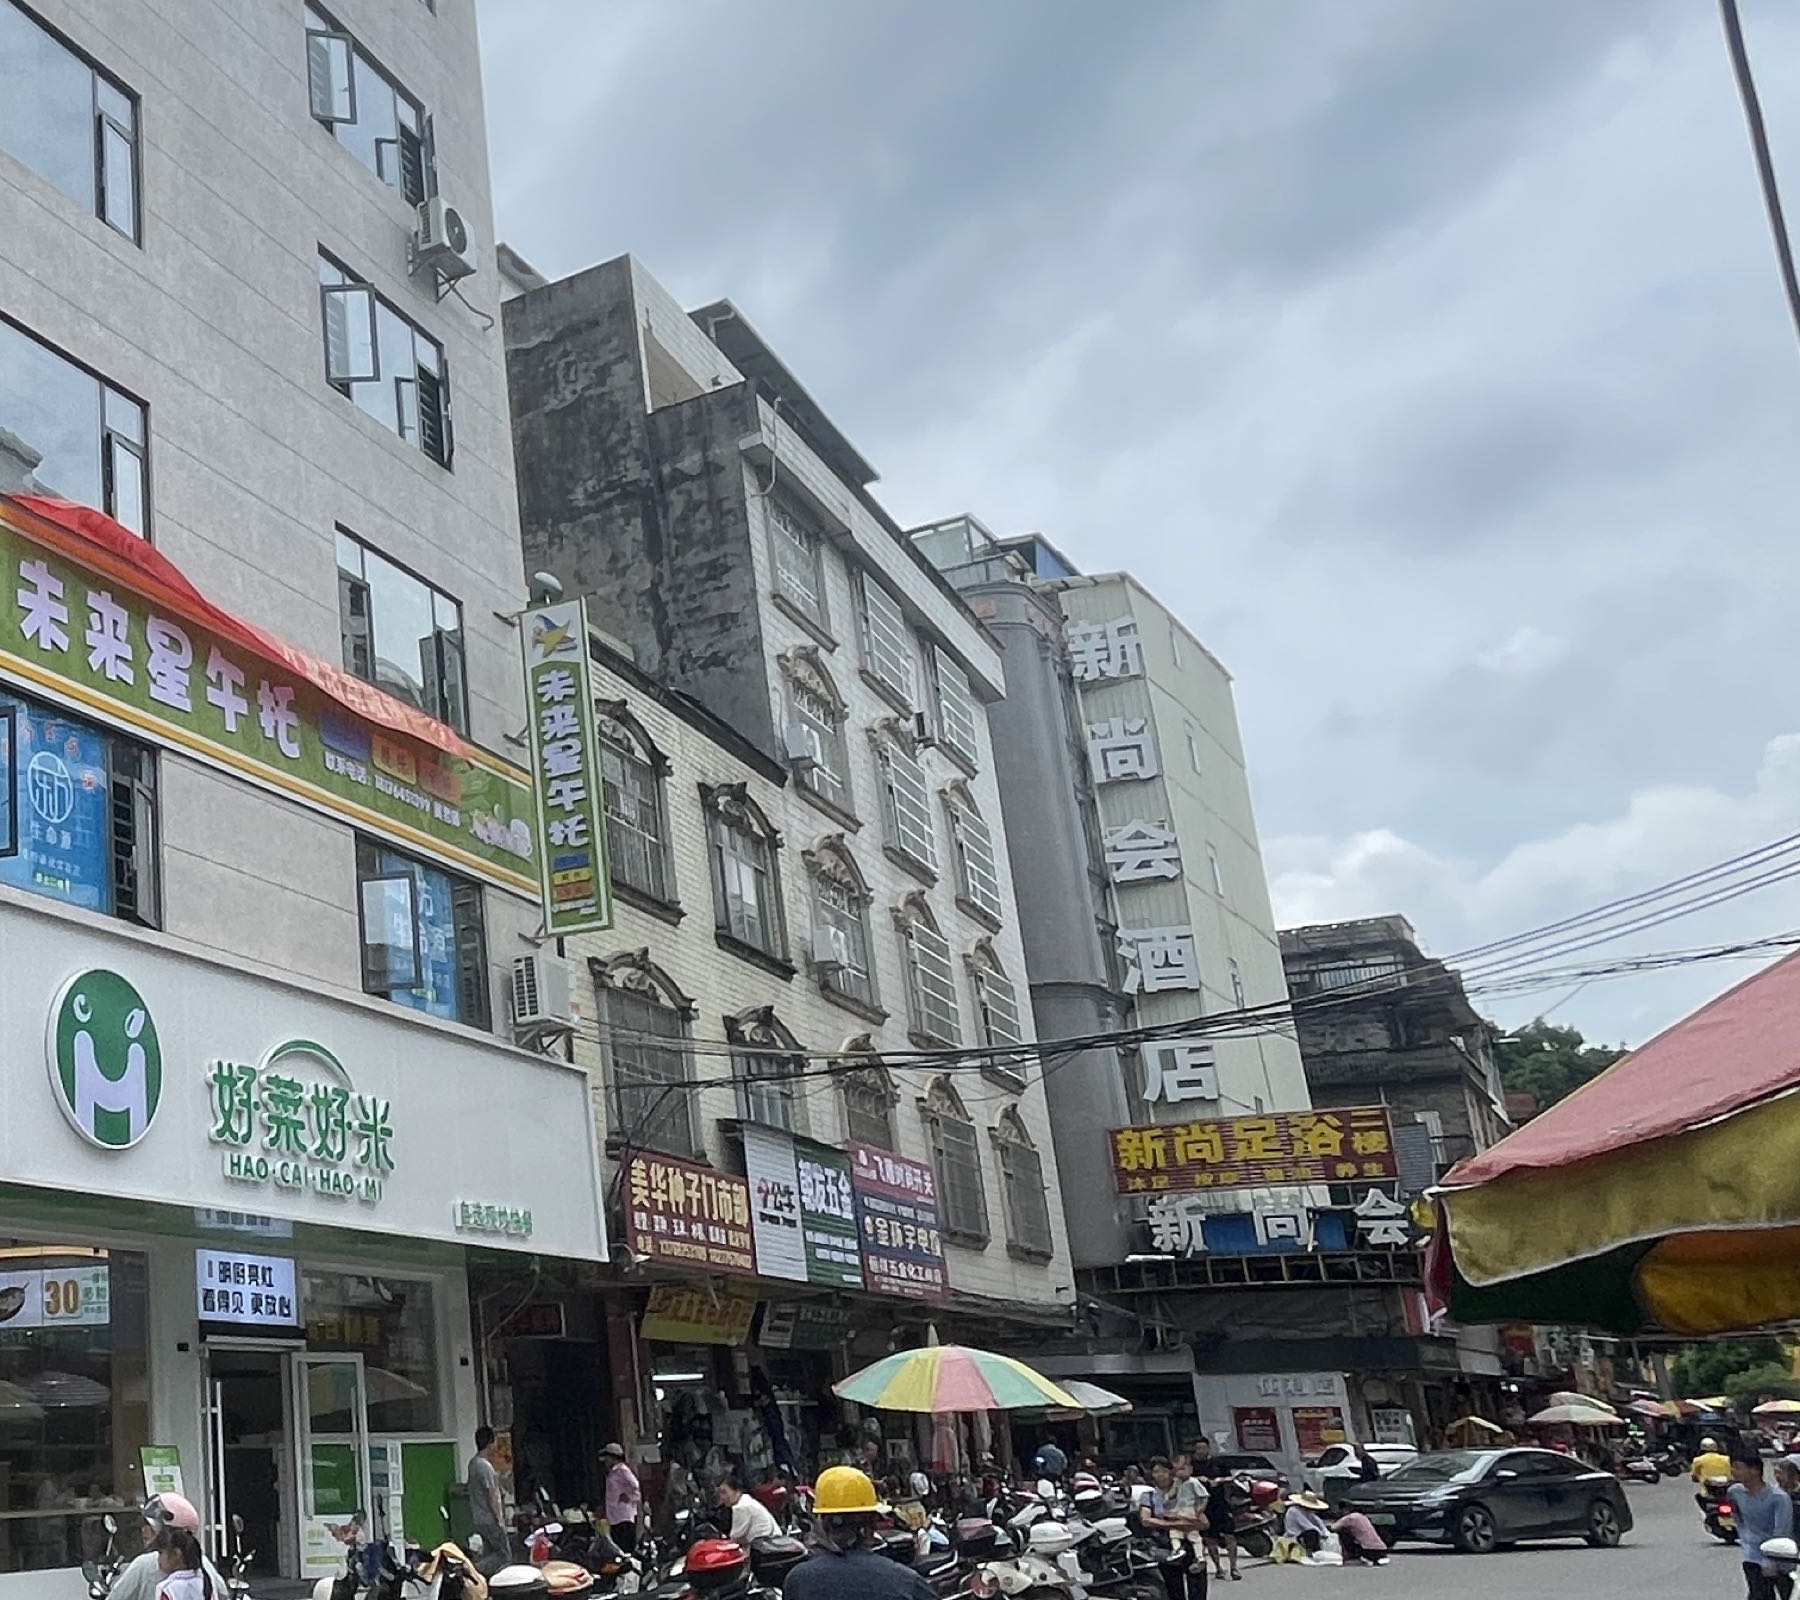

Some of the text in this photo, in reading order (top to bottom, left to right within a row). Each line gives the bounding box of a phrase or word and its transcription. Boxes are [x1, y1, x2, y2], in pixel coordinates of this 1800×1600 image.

[17, 560, 300, 759] 未来星午托
[537, 669, 589, 847] 未来星午托
[1069, 615, 1219, 1103] 新尚会酒店
[206, 1060, 394, 1170] 好菜好米
[1117, 1114, 1344, 1170] 新尚足浴
[45, 1280, 79, 1315] 30
